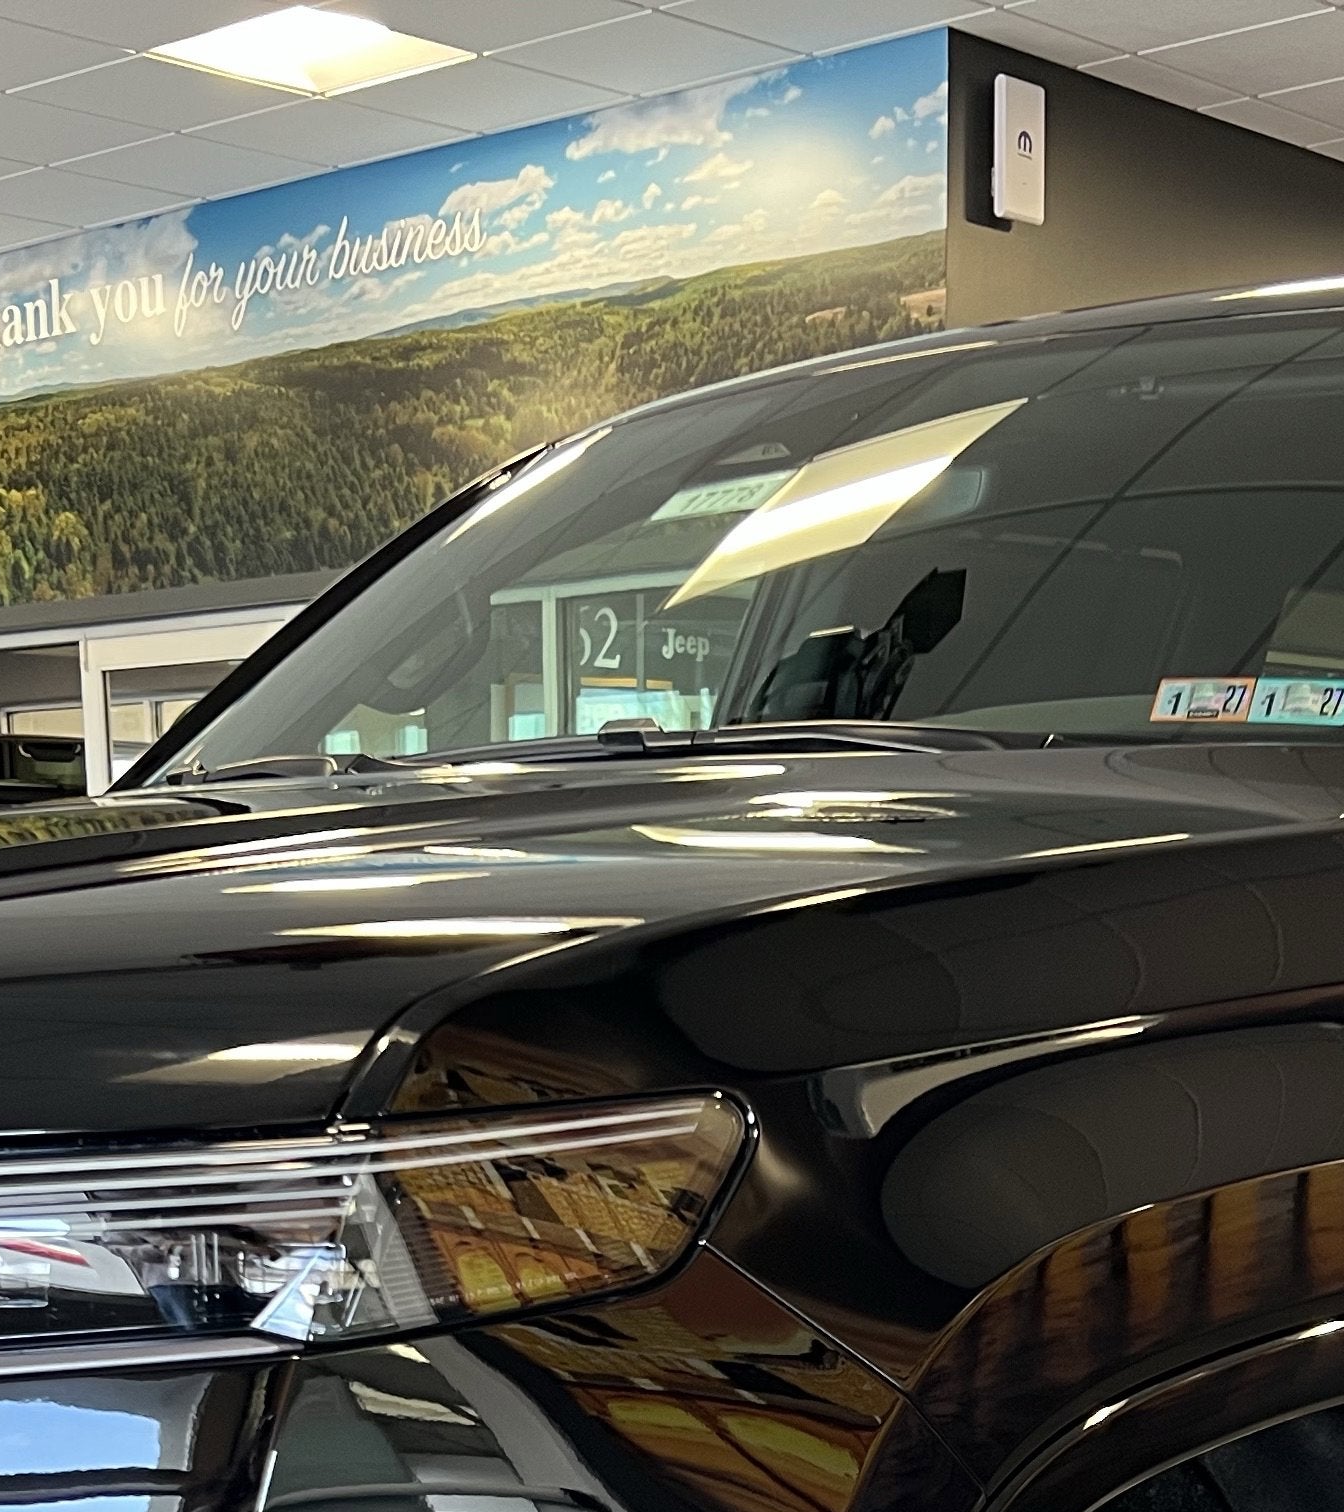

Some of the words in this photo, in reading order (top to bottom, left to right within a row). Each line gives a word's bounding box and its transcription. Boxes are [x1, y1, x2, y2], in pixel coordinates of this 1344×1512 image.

[89, 273, 166, 345] you
[174, 252, 226, 337] for
[231, 245, 320, 331] your
[328, 208, 487, 280] business
[661, 626, 711, 662] Jeep
[1167, 692, 1184, 716] 1
[1221, 684, 1248, 714] 27
[1260, 690, 1278, 718] 1
